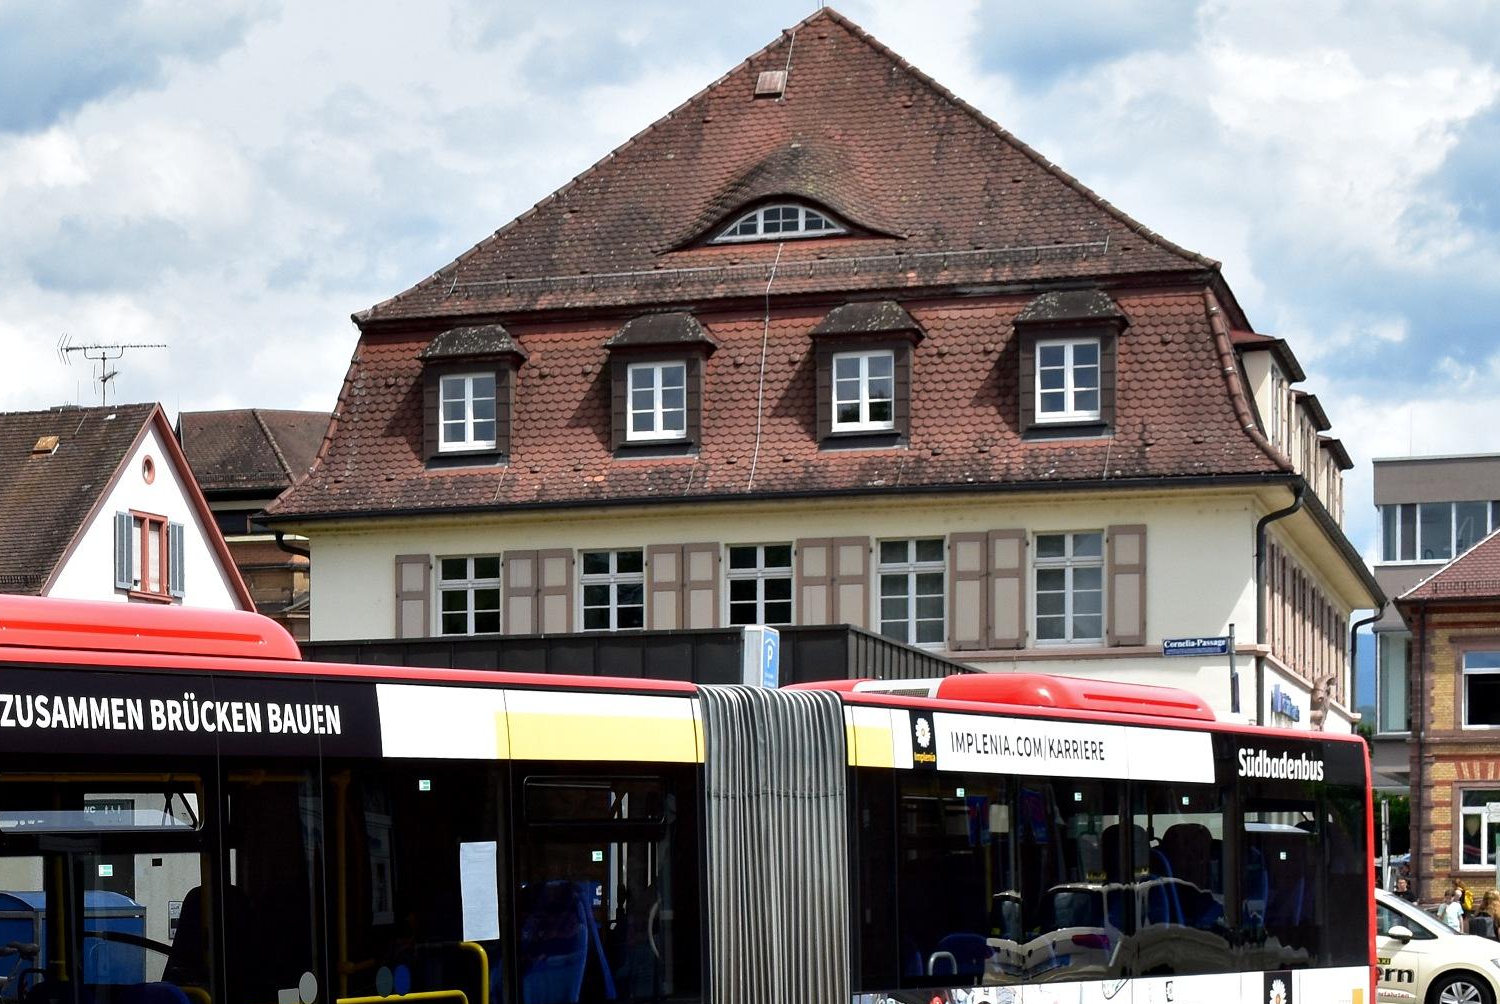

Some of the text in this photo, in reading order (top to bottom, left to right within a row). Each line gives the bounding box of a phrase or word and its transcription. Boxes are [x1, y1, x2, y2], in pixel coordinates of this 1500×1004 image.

[767, 645, 774, 669] P
[1164, 638, 1226, 649] Cornelia-Passage
[0, 694, 145, 731] ZUSAMMEN
[151, 692, 263, 733] BRÜCKEN
[268, 702, 342, 735] BAUEN
[950, 731, 1105, 761] IMPLENIA.COM/KARRIERE
[1238, 747, 1325, 783] Südbadenbus
